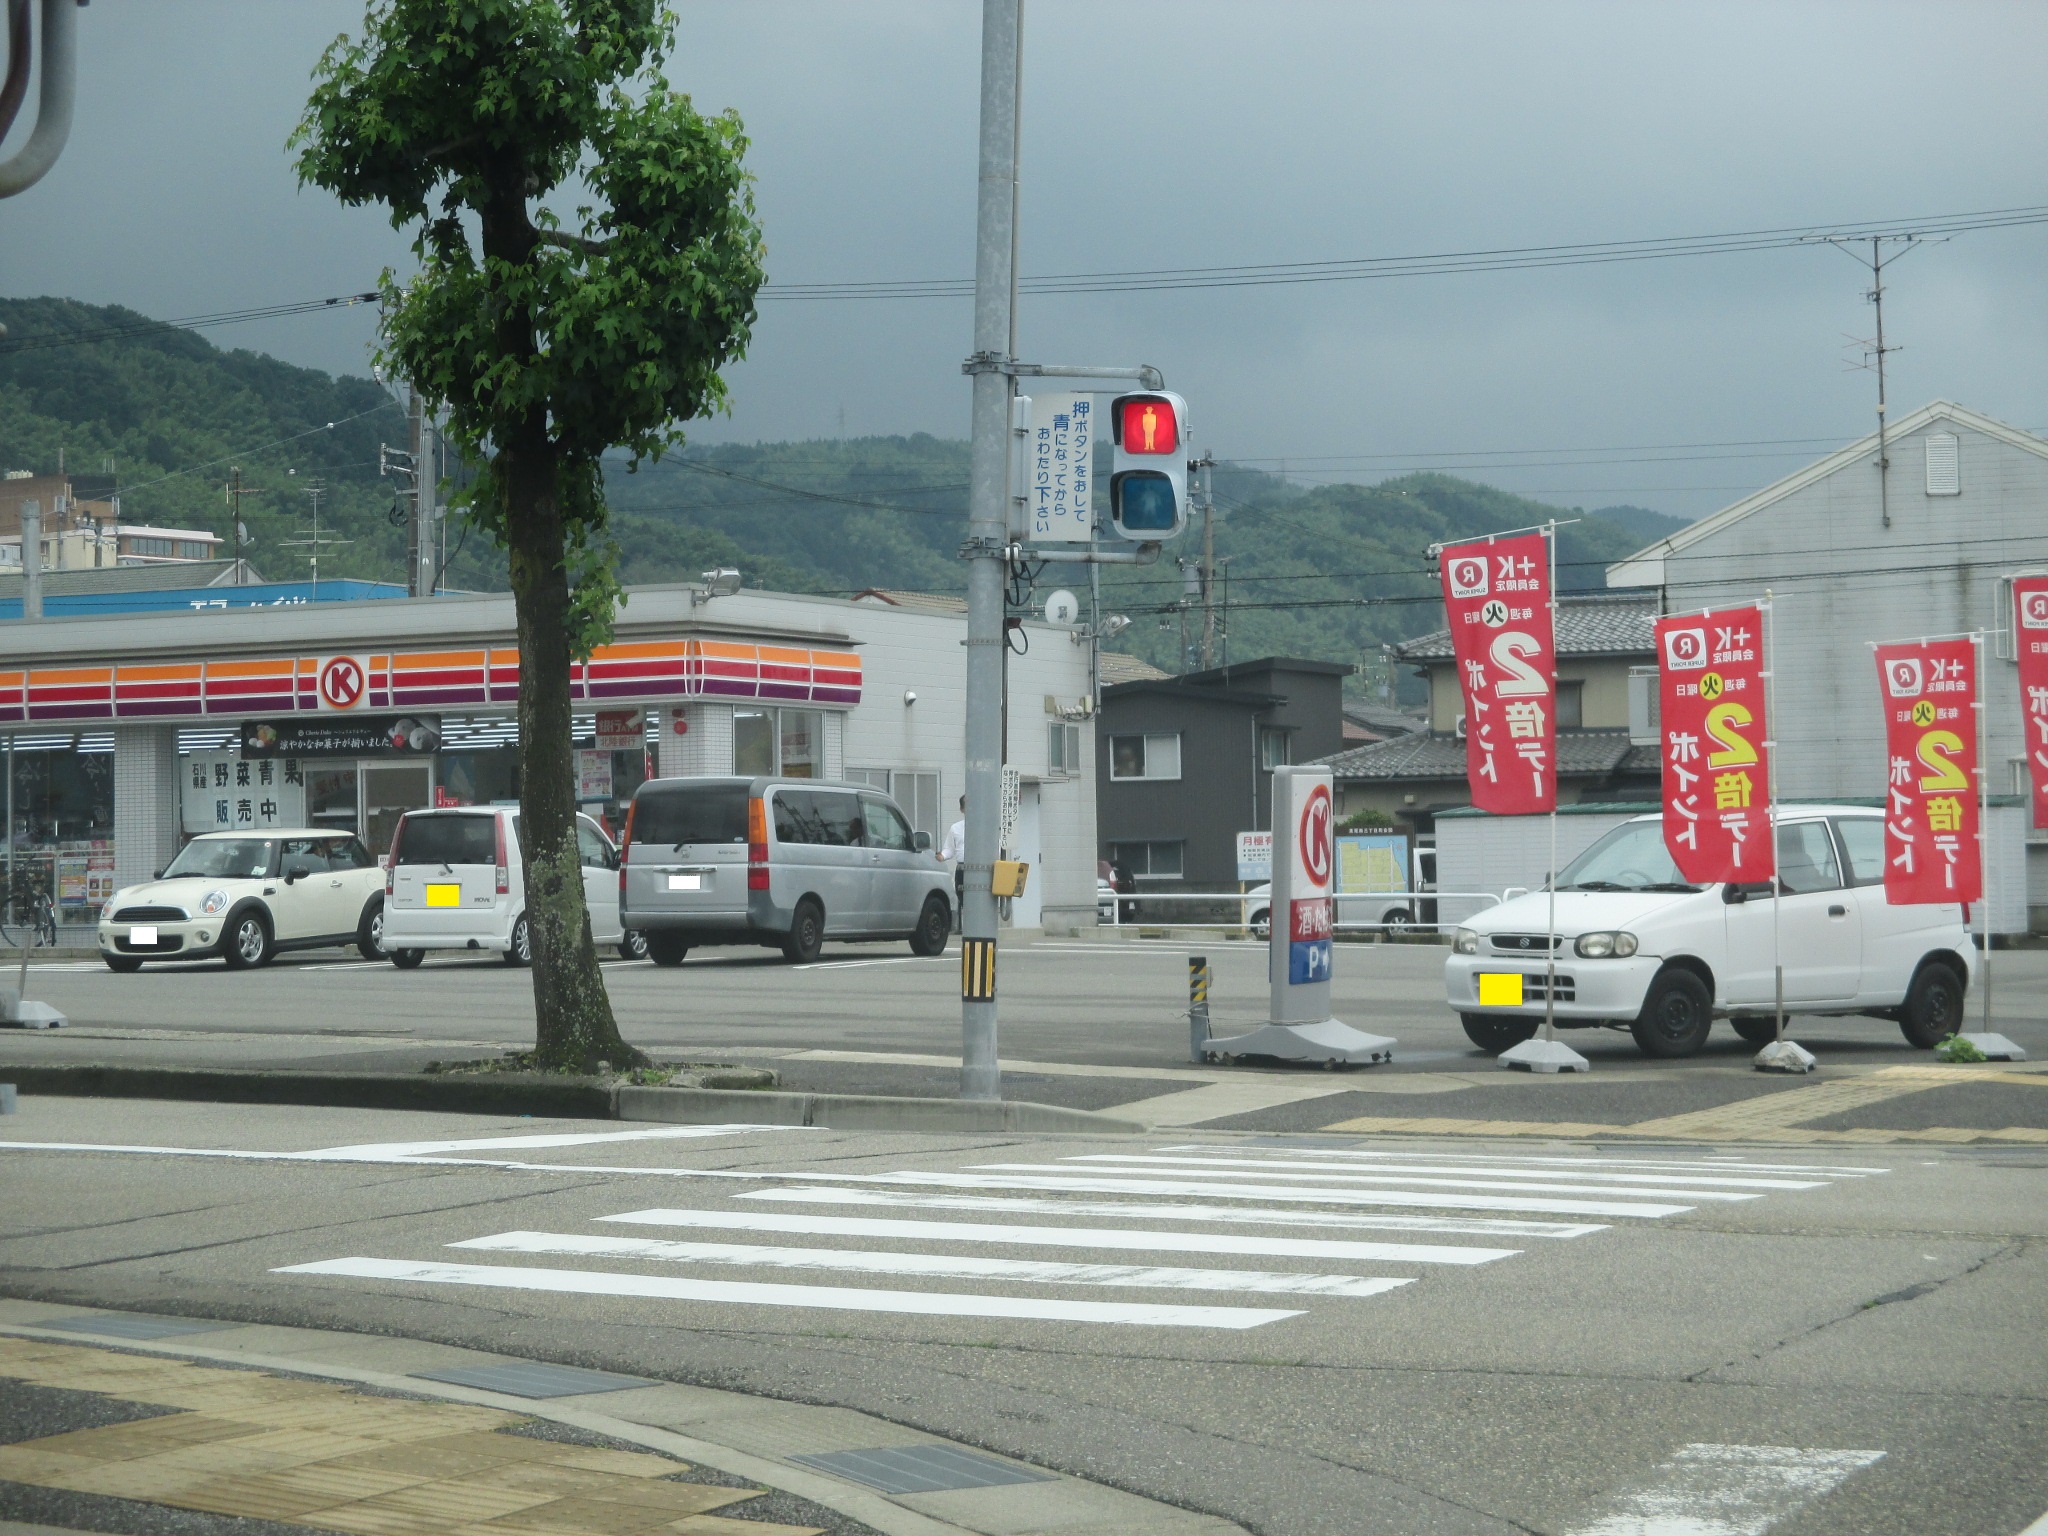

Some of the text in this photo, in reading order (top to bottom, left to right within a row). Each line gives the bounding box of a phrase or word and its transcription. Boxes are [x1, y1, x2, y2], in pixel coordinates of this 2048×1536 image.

[1034, 427, 1052, 533] おわたり下さい
[1053, 414, 1071, 516] 青になってから
[1072, 401, 1090, 522] 押ボタンをおして
[600, 736, 637, 747] 北陸銀行
